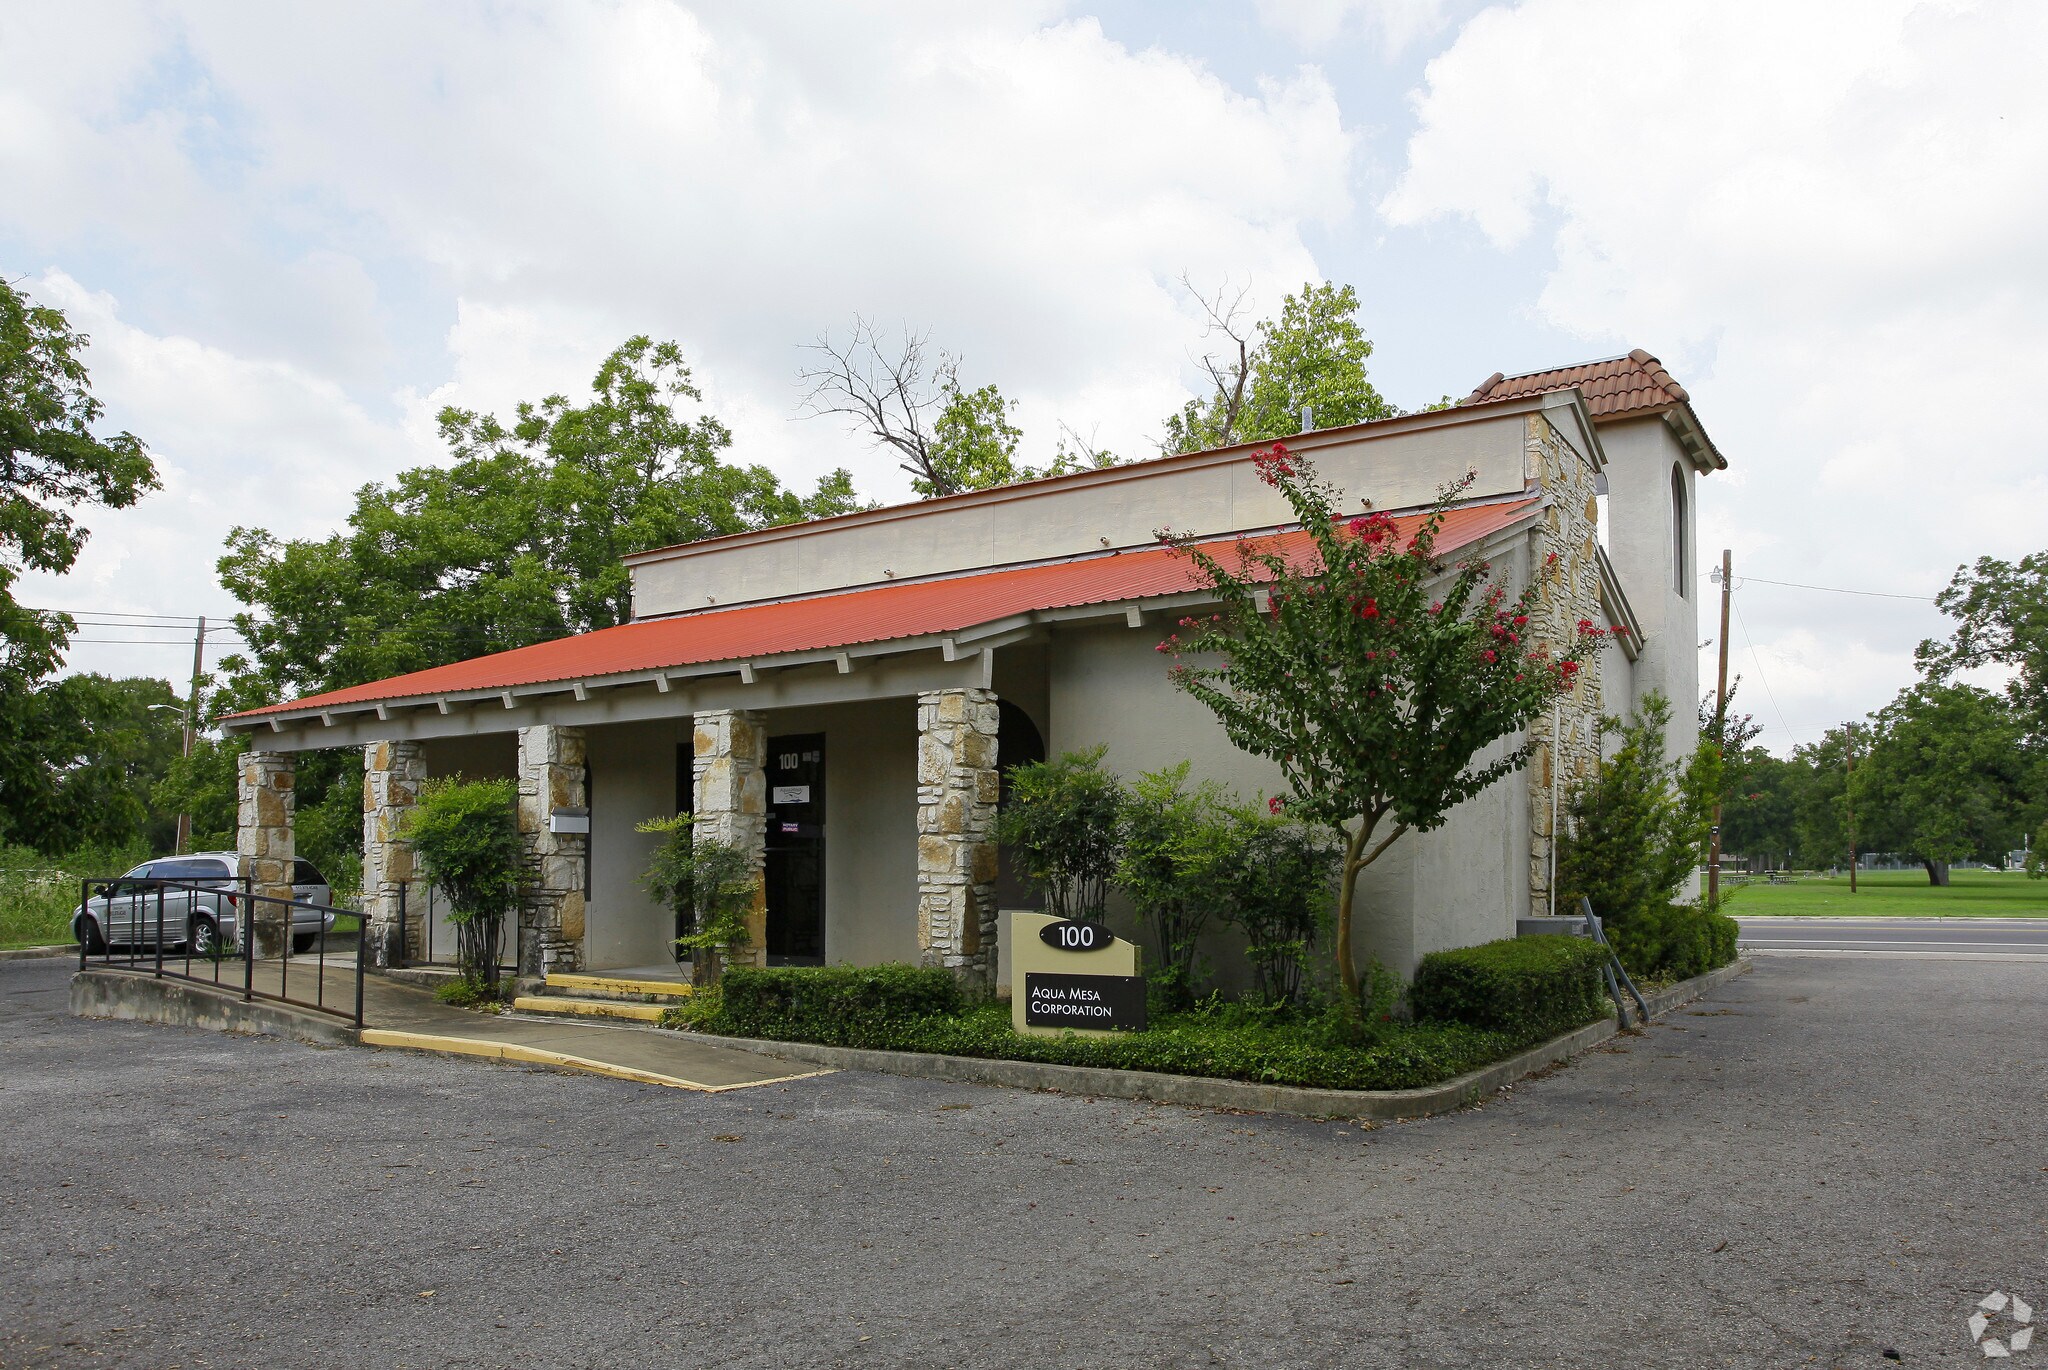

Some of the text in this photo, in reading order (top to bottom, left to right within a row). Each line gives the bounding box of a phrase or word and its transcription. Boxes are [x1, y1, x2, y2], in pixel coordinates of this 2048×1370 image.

[779, 753, 798, 770] 100
[1058, 926, 1094, 947] 100
[1031, 986, 1101, 1001] AQUA MESA
[1031, 1000, 1112, 1018] CORPORATION
